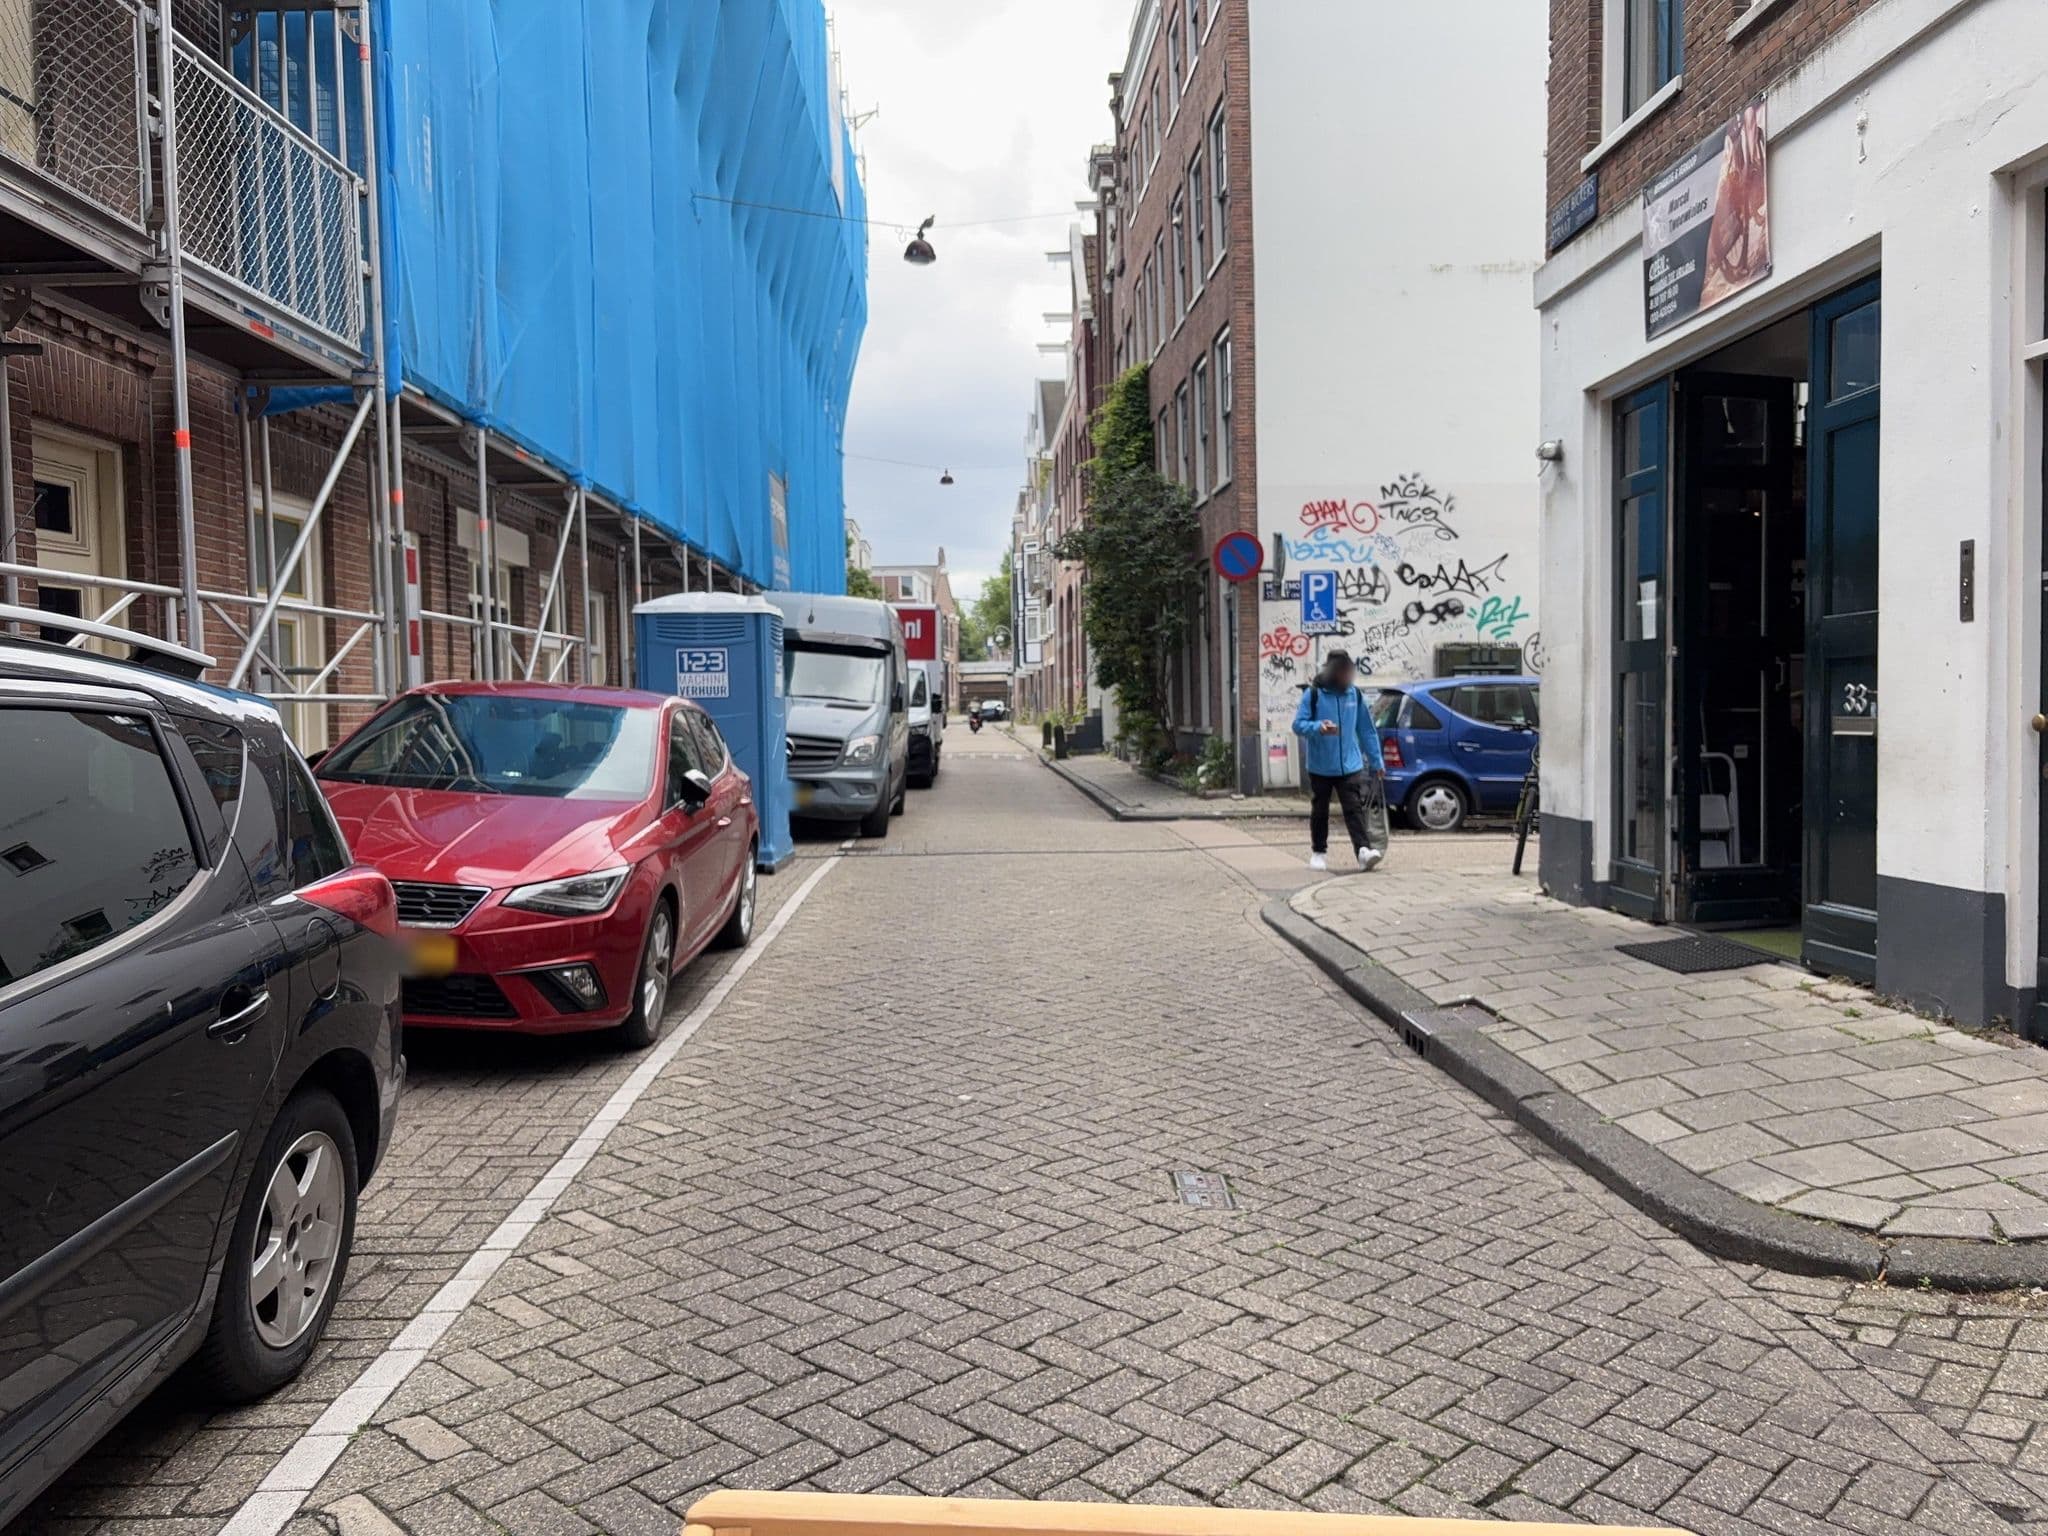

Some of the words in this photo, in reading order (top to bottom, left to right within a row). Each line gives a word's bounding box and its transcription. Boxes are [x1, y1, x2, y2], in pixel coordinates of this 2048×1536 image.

[1309, 574, 1328, 602] P
[679, 674, 726, 687] MACHINE
[680, 686, 727, 697] VERHUUR
[1843, 682, 1869, 714] 33
